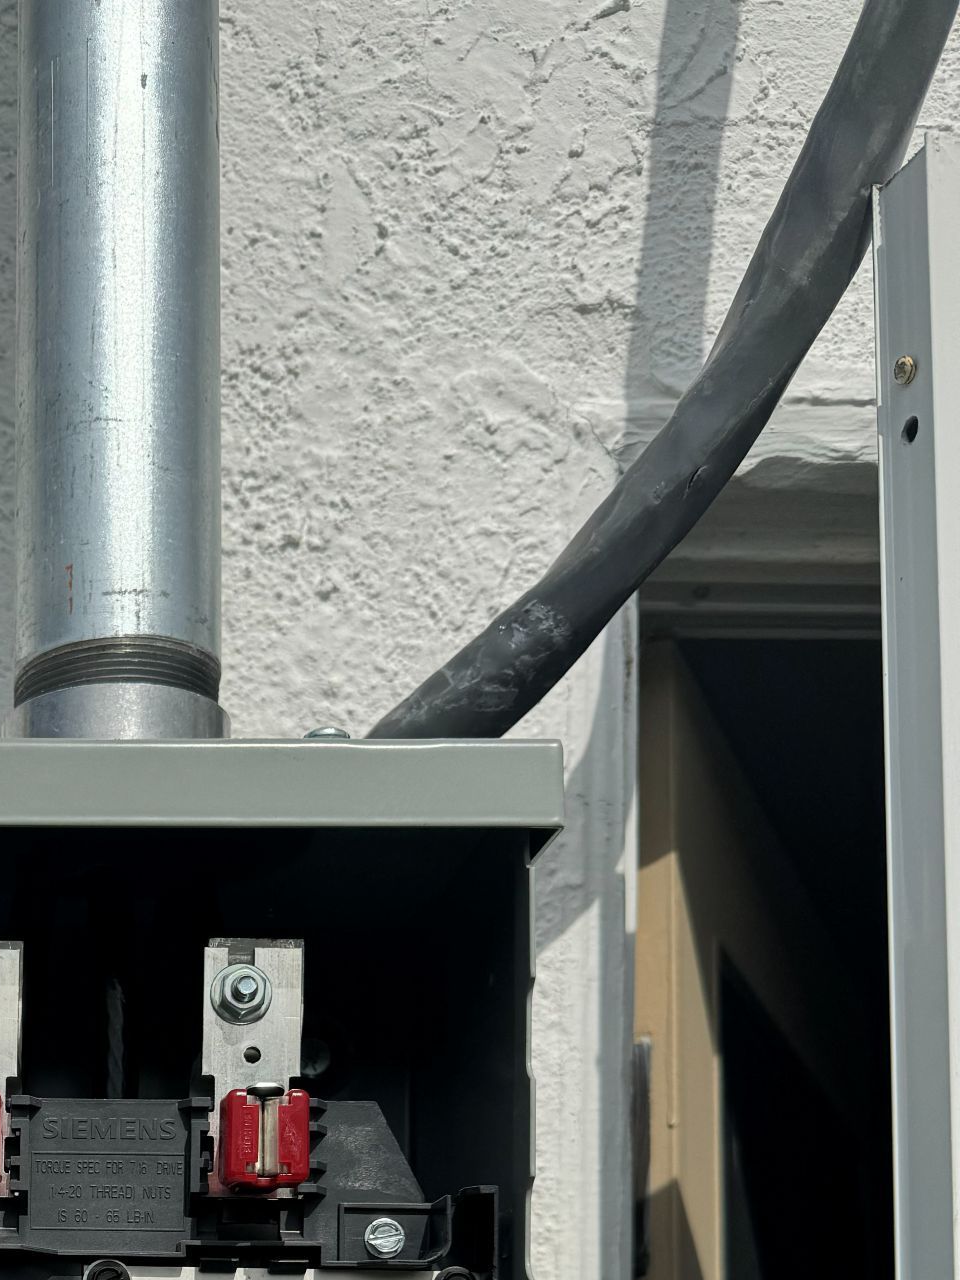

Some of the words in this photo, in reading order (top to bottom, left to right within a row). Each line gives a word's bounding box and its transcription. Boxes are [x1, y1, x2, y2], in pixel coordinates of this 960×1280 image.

[42, 1117, 177, 1140] SIEMENS
[35, 1160, 71, 1175] TORQUE
[76, 1160, 101, 1175] SPEC
[106, 1160, 124, 1175] FOR
[156, 1161, 183, 1176] DRIVE
[142, 1185, 172, 1200] NUTS
[58, 1208, 67, 1223] IS
[74, 1208, 88, 1223] 60
[106, 1208, 120, 1223] 65
[127, 1208, 154, 1224] LB-IN
